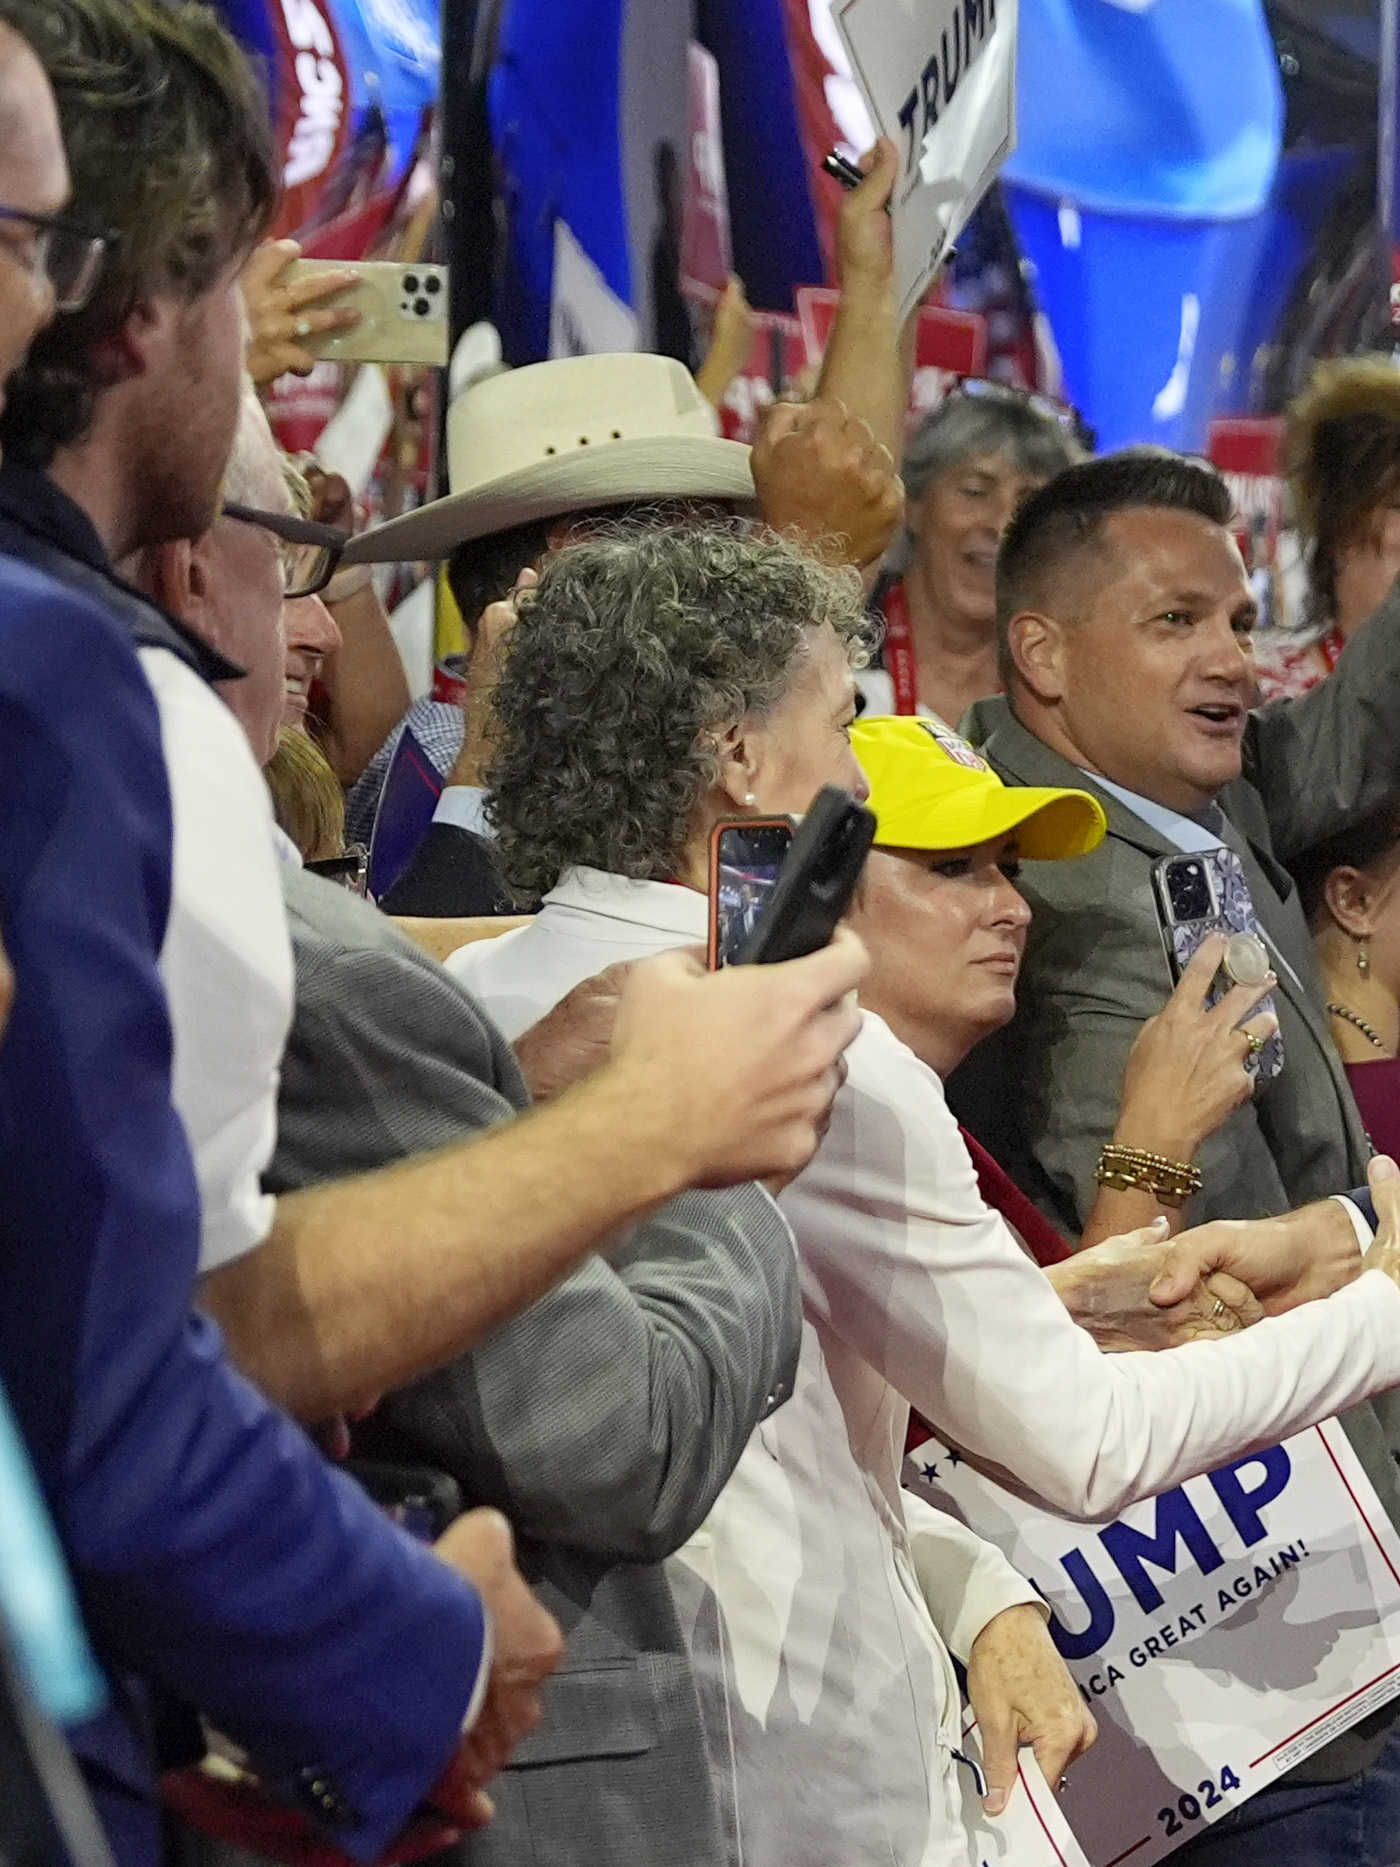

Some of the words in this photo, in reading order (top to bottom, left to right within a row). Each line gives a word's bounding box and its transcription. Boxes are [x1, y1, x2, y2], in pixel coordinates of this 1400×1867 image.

[896, 0, 996, 174] TRUM
[1028, 1443, 1291, 1660] UMP
[1129, 1603, 1207, 1668] GREAT
[1216, 1538, 1311, 1611] AGAIN!
[1157, 1765, 1241, 1837] 2024
